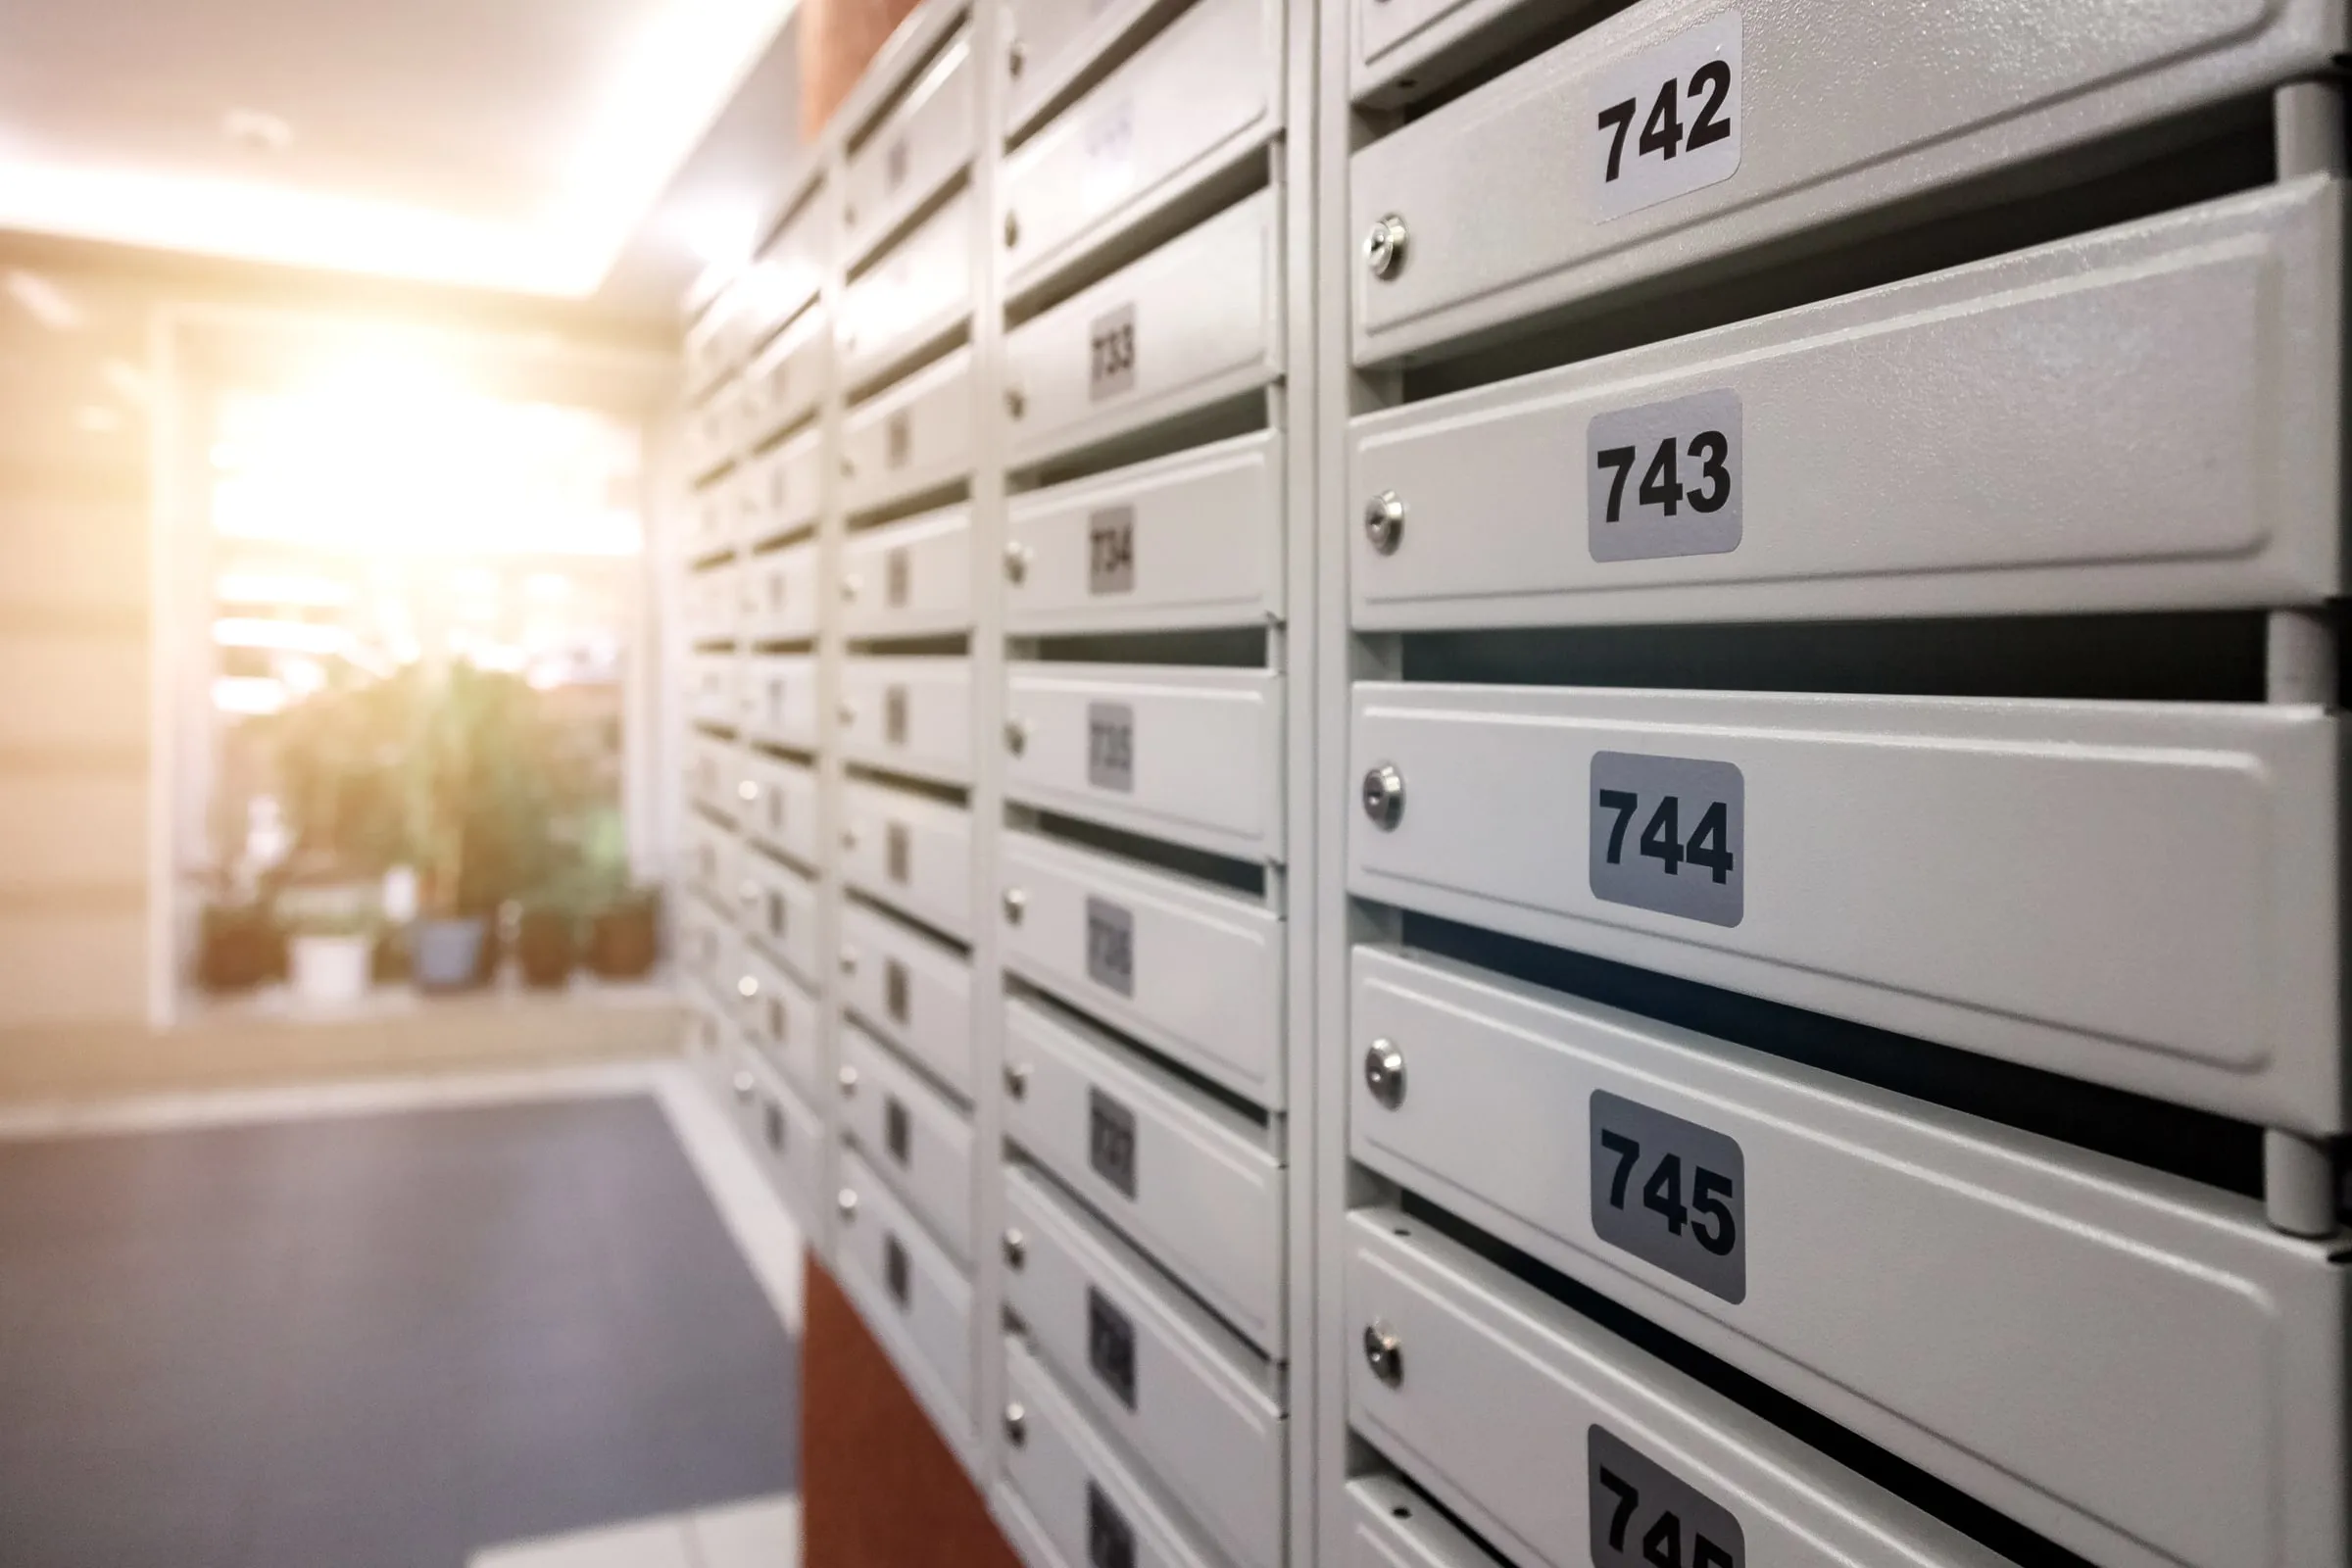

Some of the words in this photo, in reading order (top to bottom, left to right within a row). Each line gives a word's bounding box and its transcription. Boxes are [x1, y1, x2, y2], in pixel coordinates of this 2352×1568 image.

[1598, 60, 1731, 183] 742
[1093, 323, 1134, 381] 733
[1597, 430, 1731, 522] 743
[1091, 523, 1133, 574] 734
[1599, 789, 1734, 885] 744
[1601, 1129, 1736, 1255] 745
